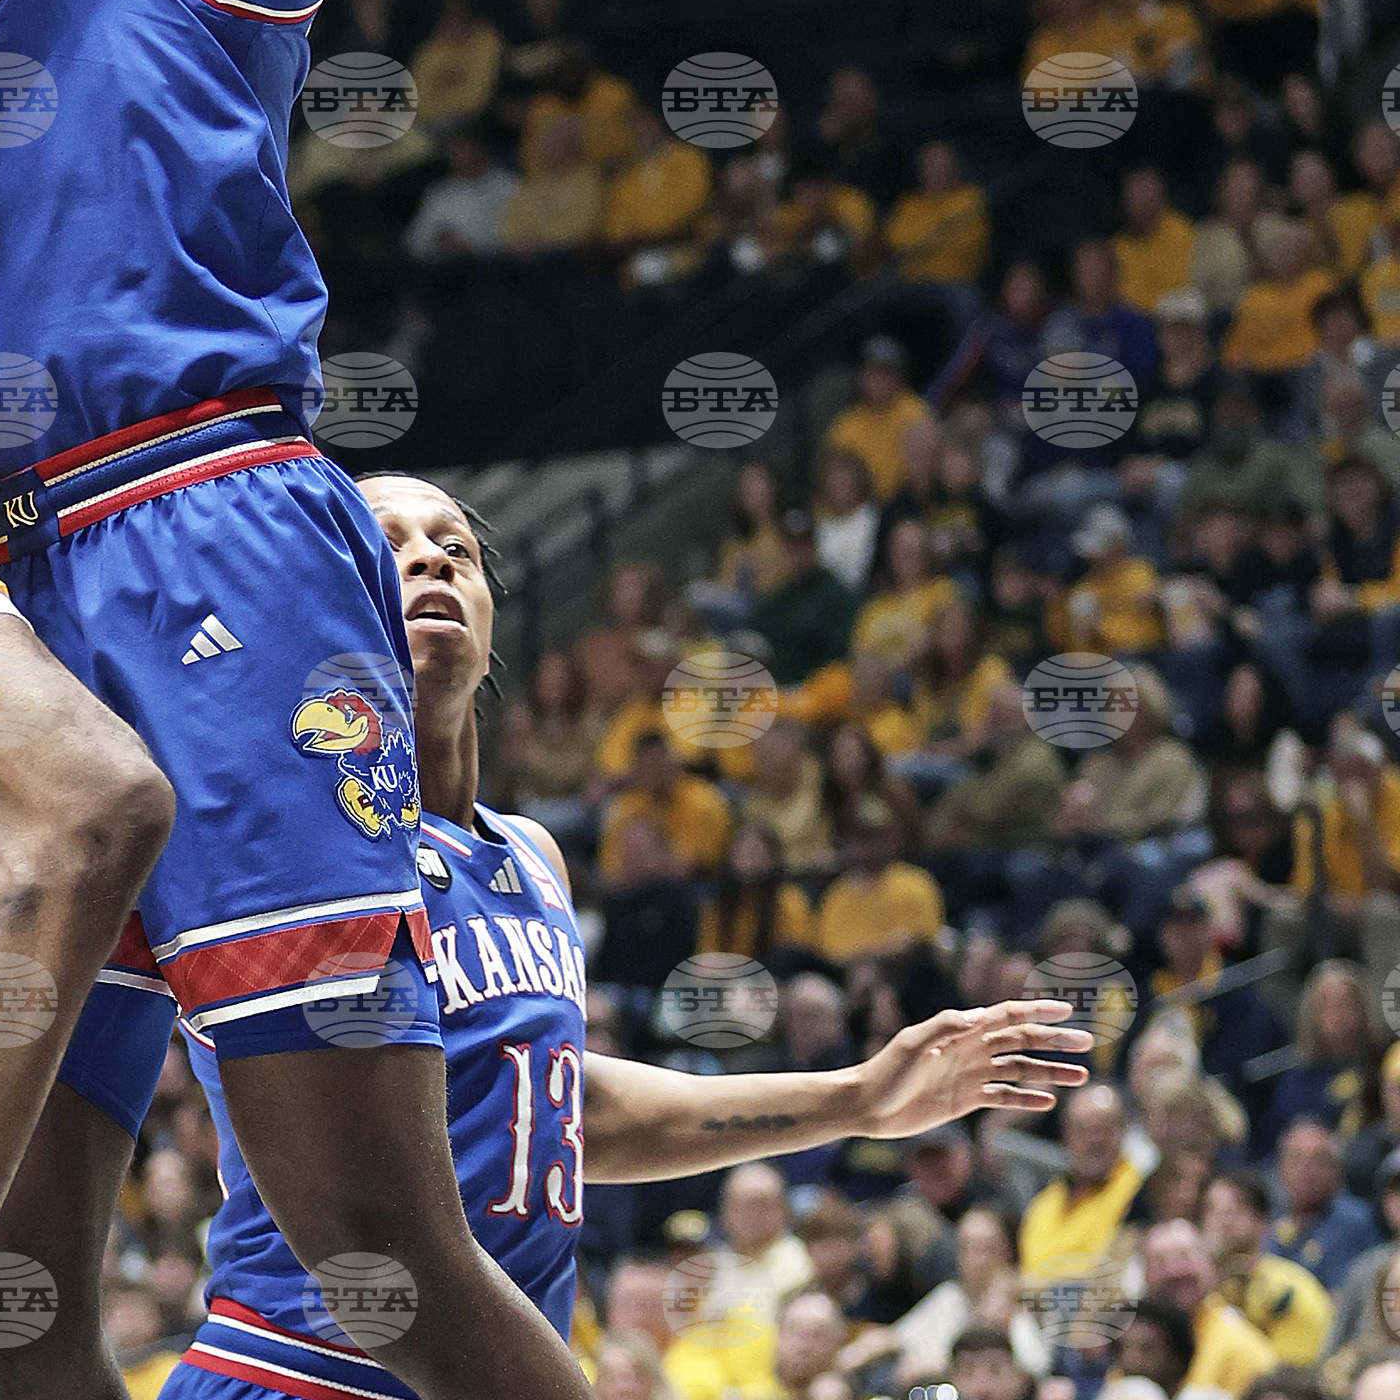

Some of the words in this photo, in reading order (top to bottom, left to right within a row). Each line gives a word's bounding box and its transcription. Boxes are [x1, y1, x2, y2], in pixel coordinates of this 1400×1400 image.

[3, 490, 39, 529] KU
[369, 764, 399, 793] KU
[488, 1042, 584, 1228] 13
